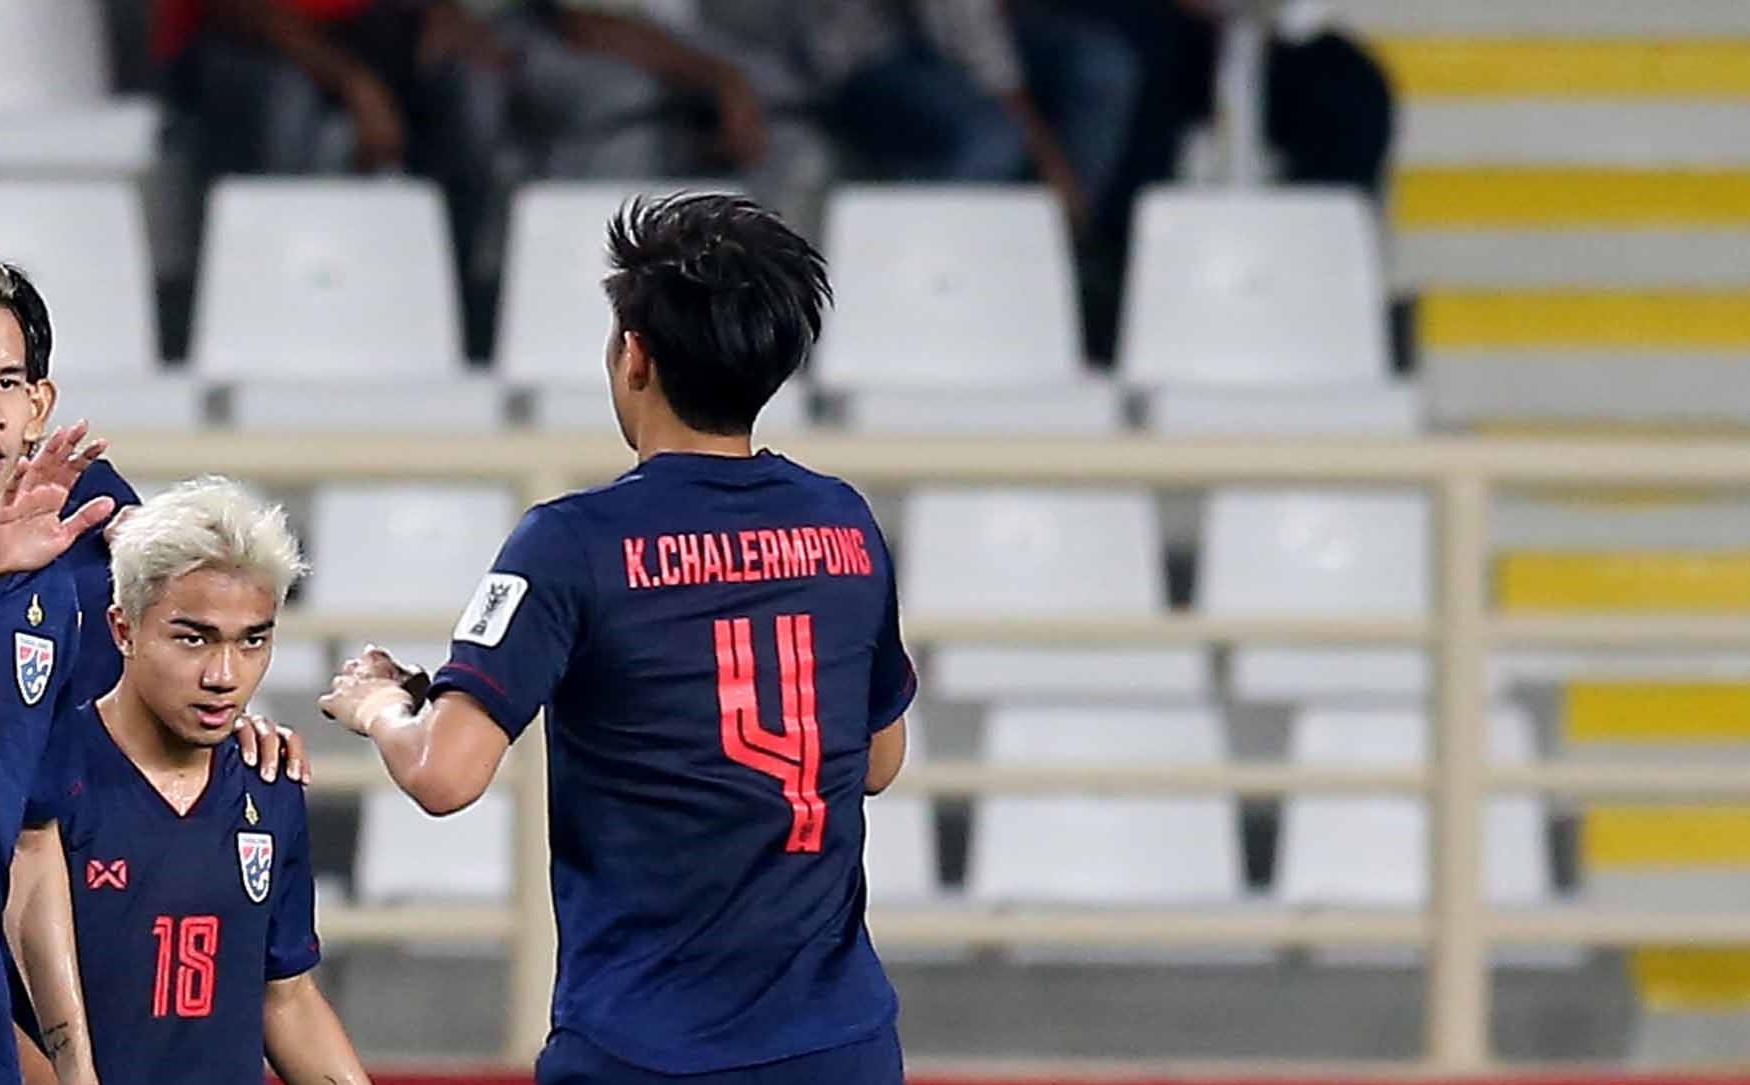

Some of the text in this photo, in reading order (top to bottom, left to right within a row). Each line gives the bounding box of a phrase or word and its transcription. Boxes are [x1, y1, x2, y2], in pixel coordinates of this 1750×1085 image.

[623, 526, 874, 588] K.CHALERMPONG
[713, 613, 827, 853] 4
[153, 914, 220, 1018] 18
